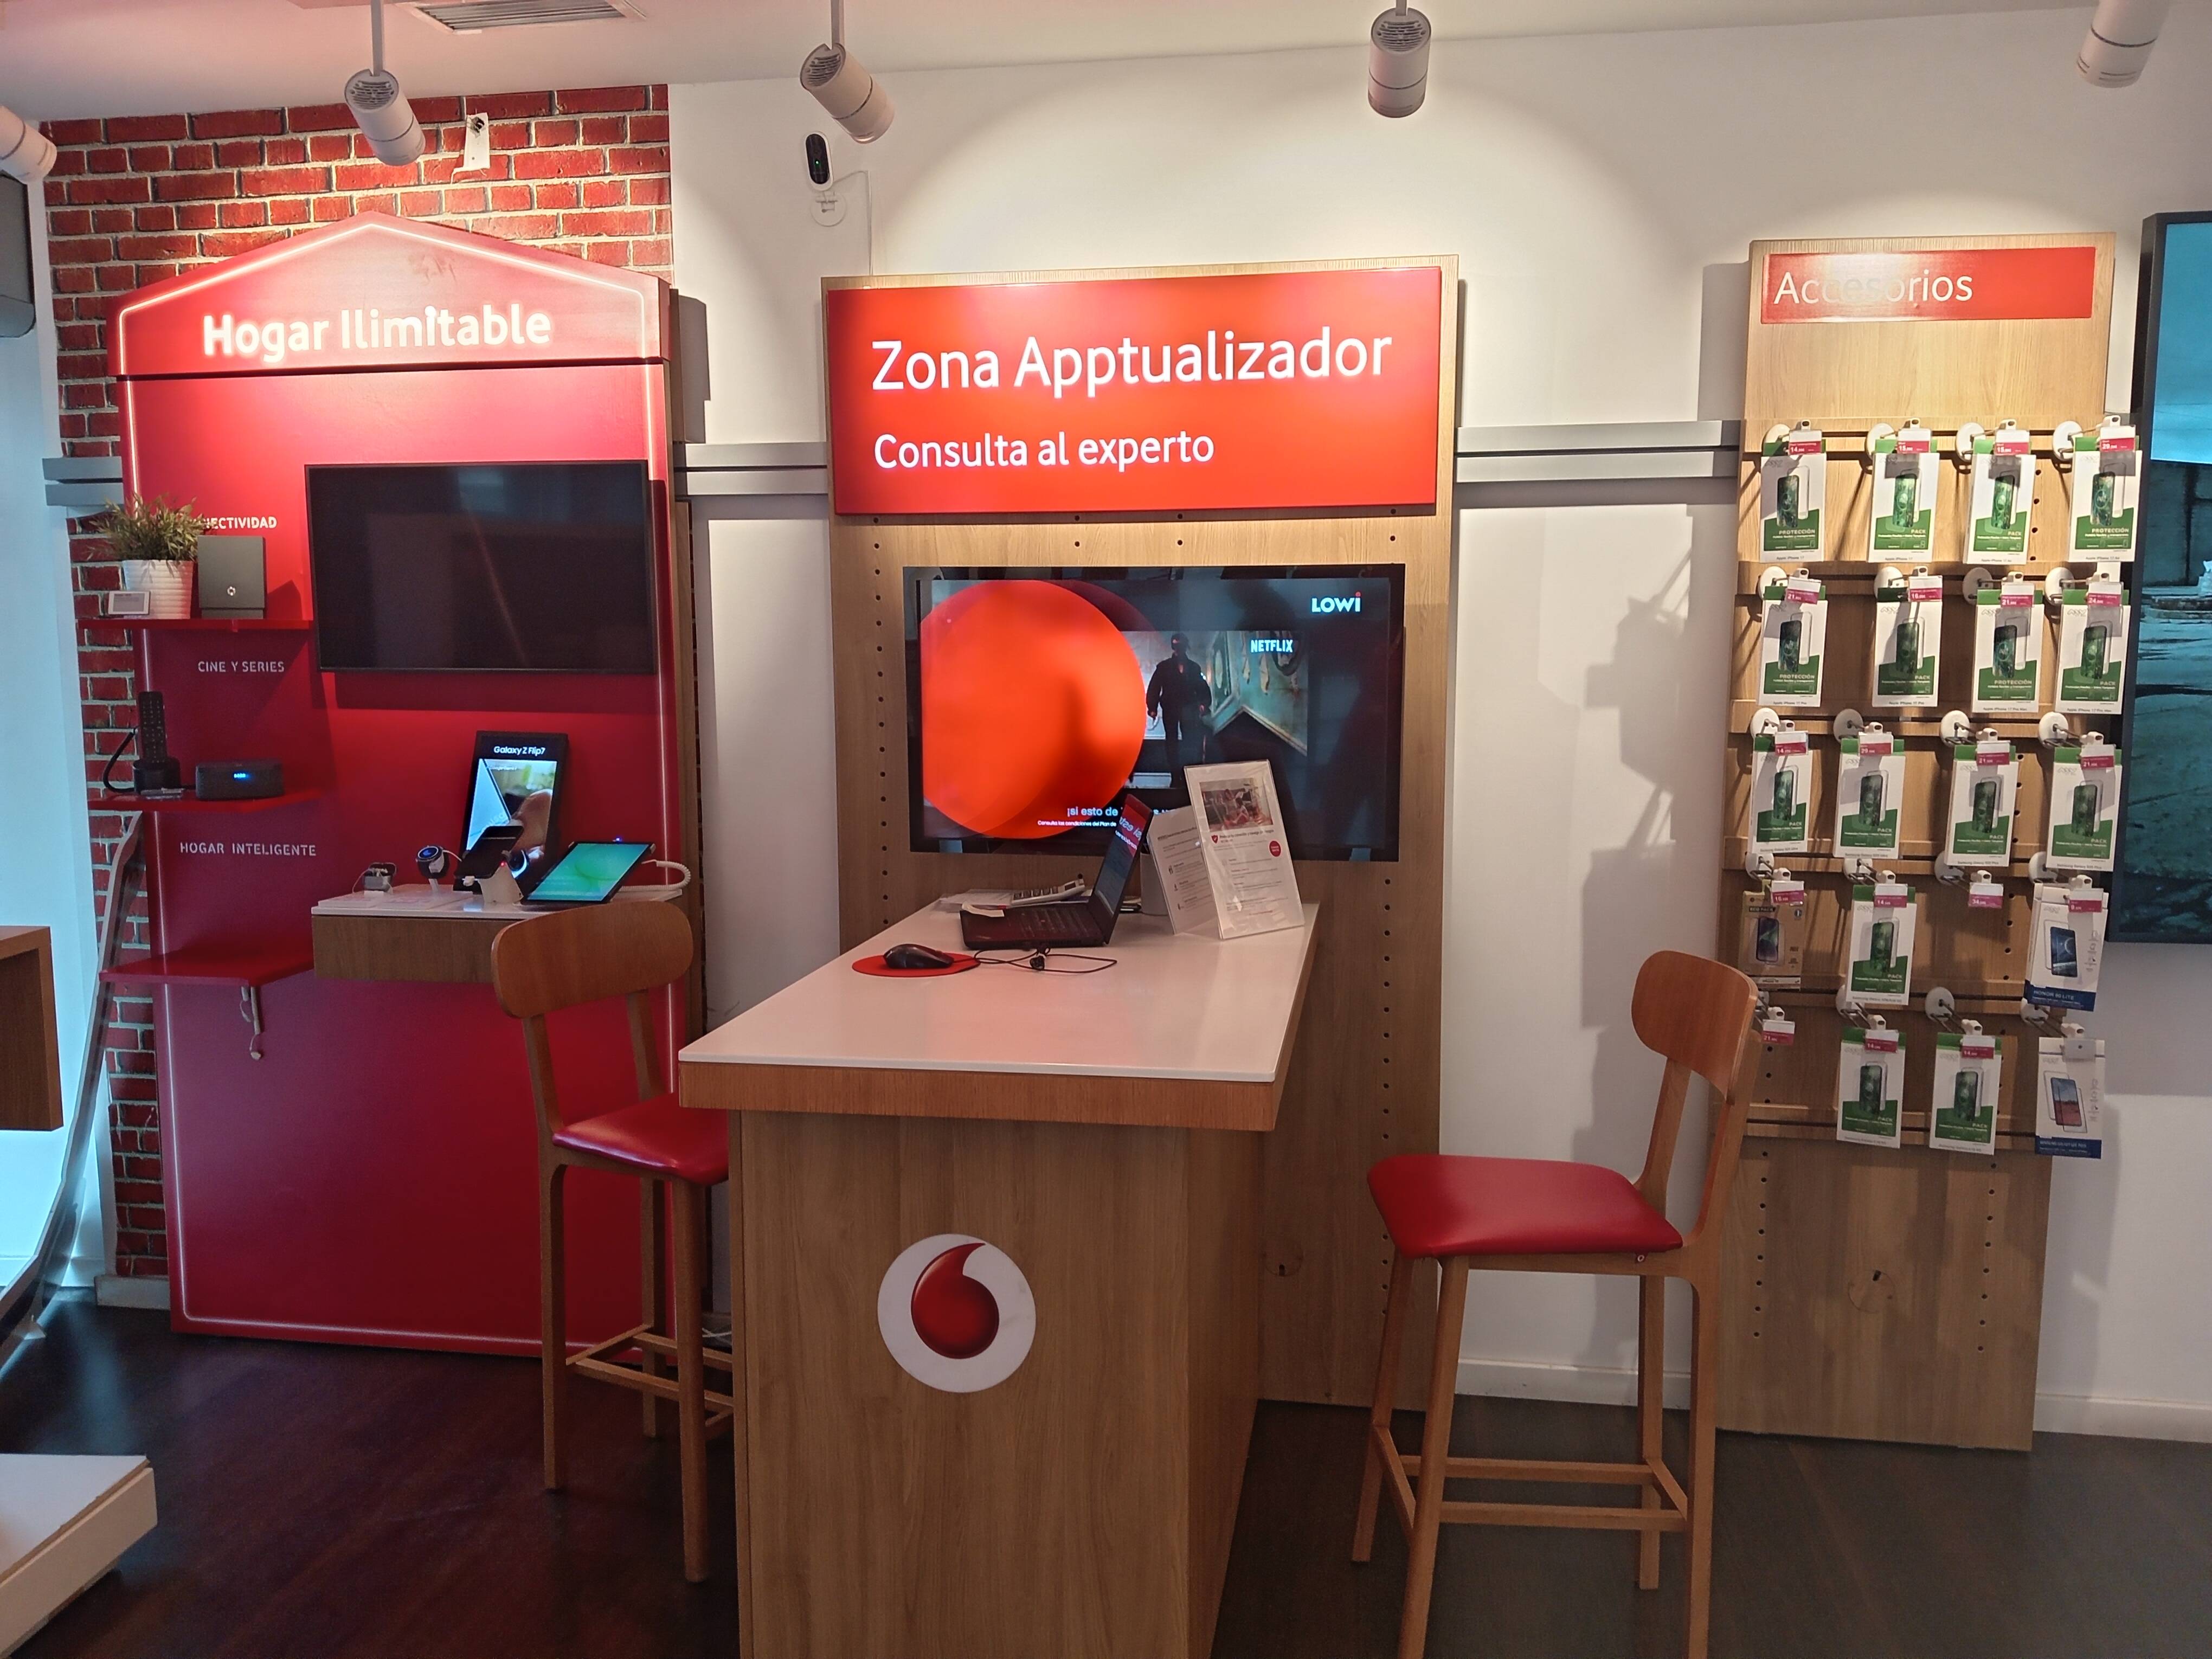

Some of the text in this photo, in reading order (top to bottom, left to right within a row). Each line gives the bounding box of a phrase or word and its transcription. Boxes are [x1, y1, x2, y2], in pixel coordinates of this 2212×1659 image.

[1773, 269, 1973, 305] Accesorios
[203, 303, 552, 363] Hogar Ilimitable
[871, 325, 1393, 399] Zona Apptualizador
[874, 430, 1215, 472] Consulta al experto
[205, 516, 277, 530] ECTIVIDAD
[1251, 639, 1293, 653] NETFLIX
[198, 661, 285, 672] CINE Y SERIES
[493, 746, 522, 755] Galaxy
[529, 747, 546, 756] Flip7
[1081, 807, 1103, 816] esto
[1105, 807, 1118, 816] de
[179, 842, 317, 856] HOGAR INTELIGENTE
